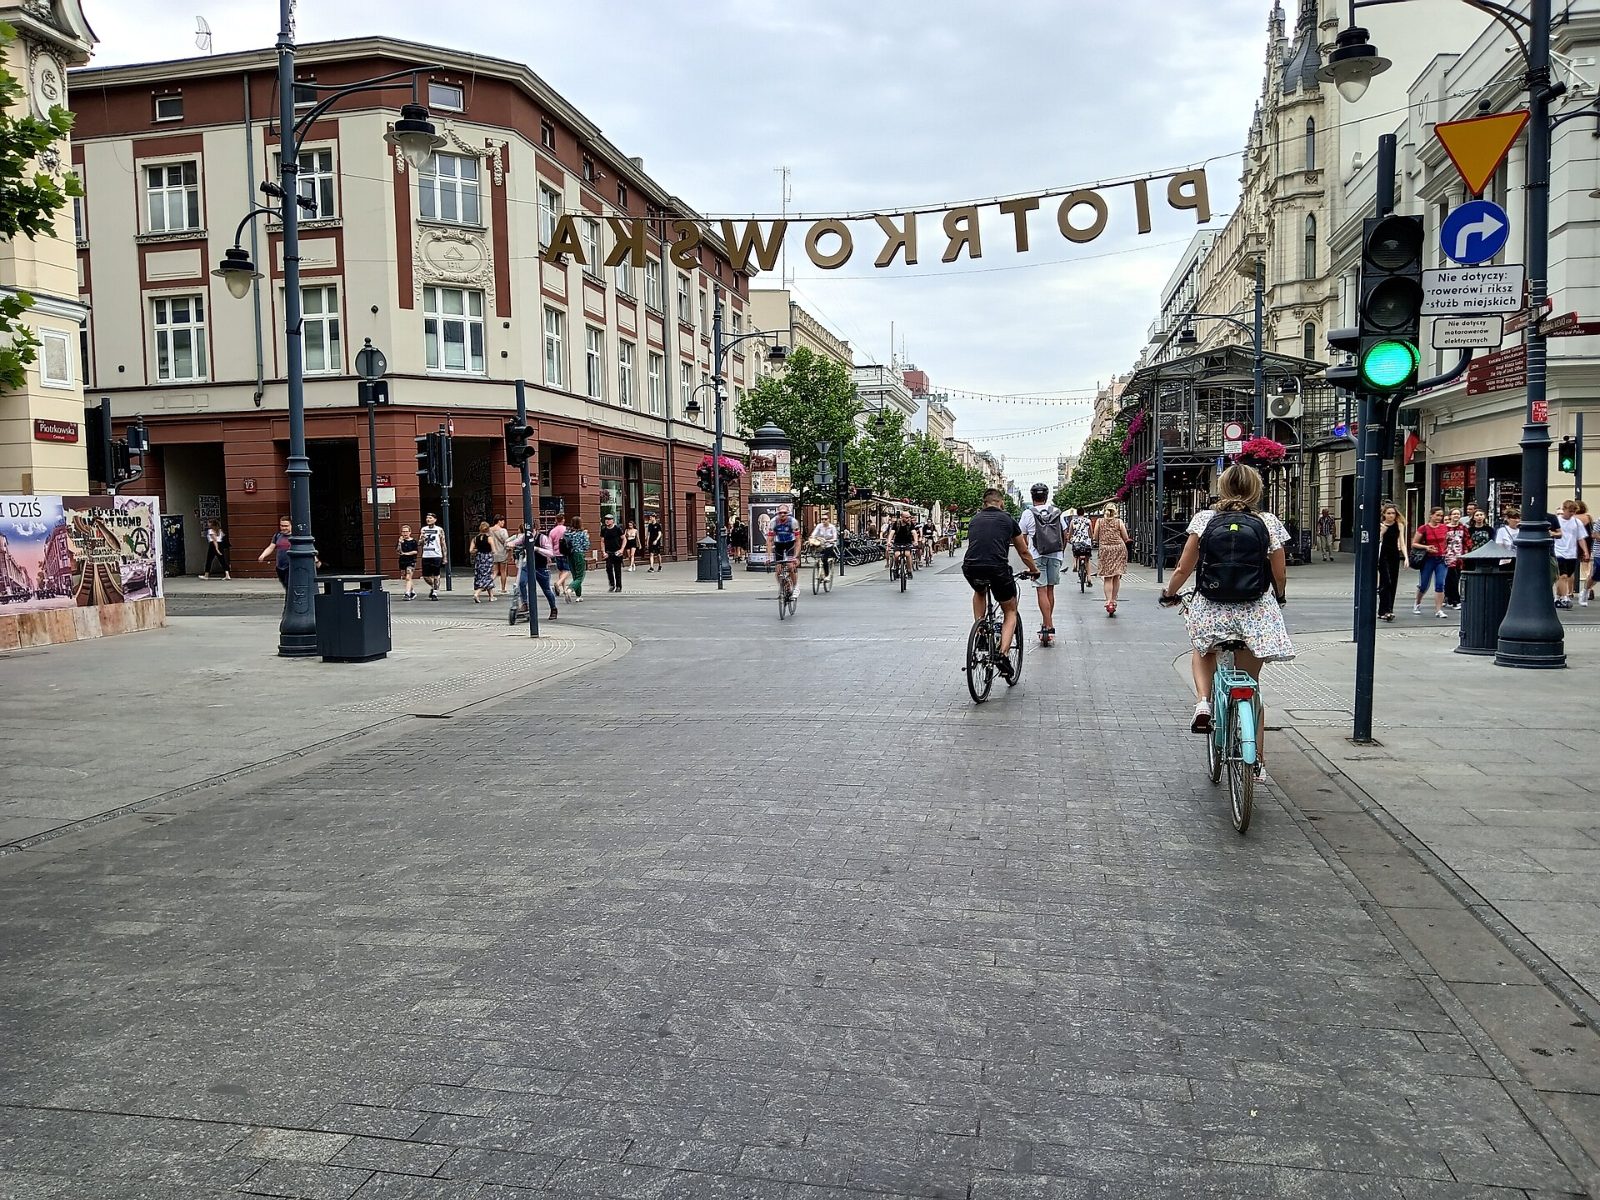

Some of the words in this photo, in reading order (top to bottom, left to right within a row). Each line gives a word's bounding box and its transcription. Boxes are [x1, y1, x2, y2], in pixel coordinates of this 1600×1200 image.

[1438, 273, 1457, 282] Nie
[1461, 272, 1508, 282] dotyczy:
[1487, 284, 1513, 293] riksz
[1463, 296, 1516, 308] miejskich
[40, 424, 75, 434] Piotrkowska
[9, 497, 42, 518] DZIŚ
